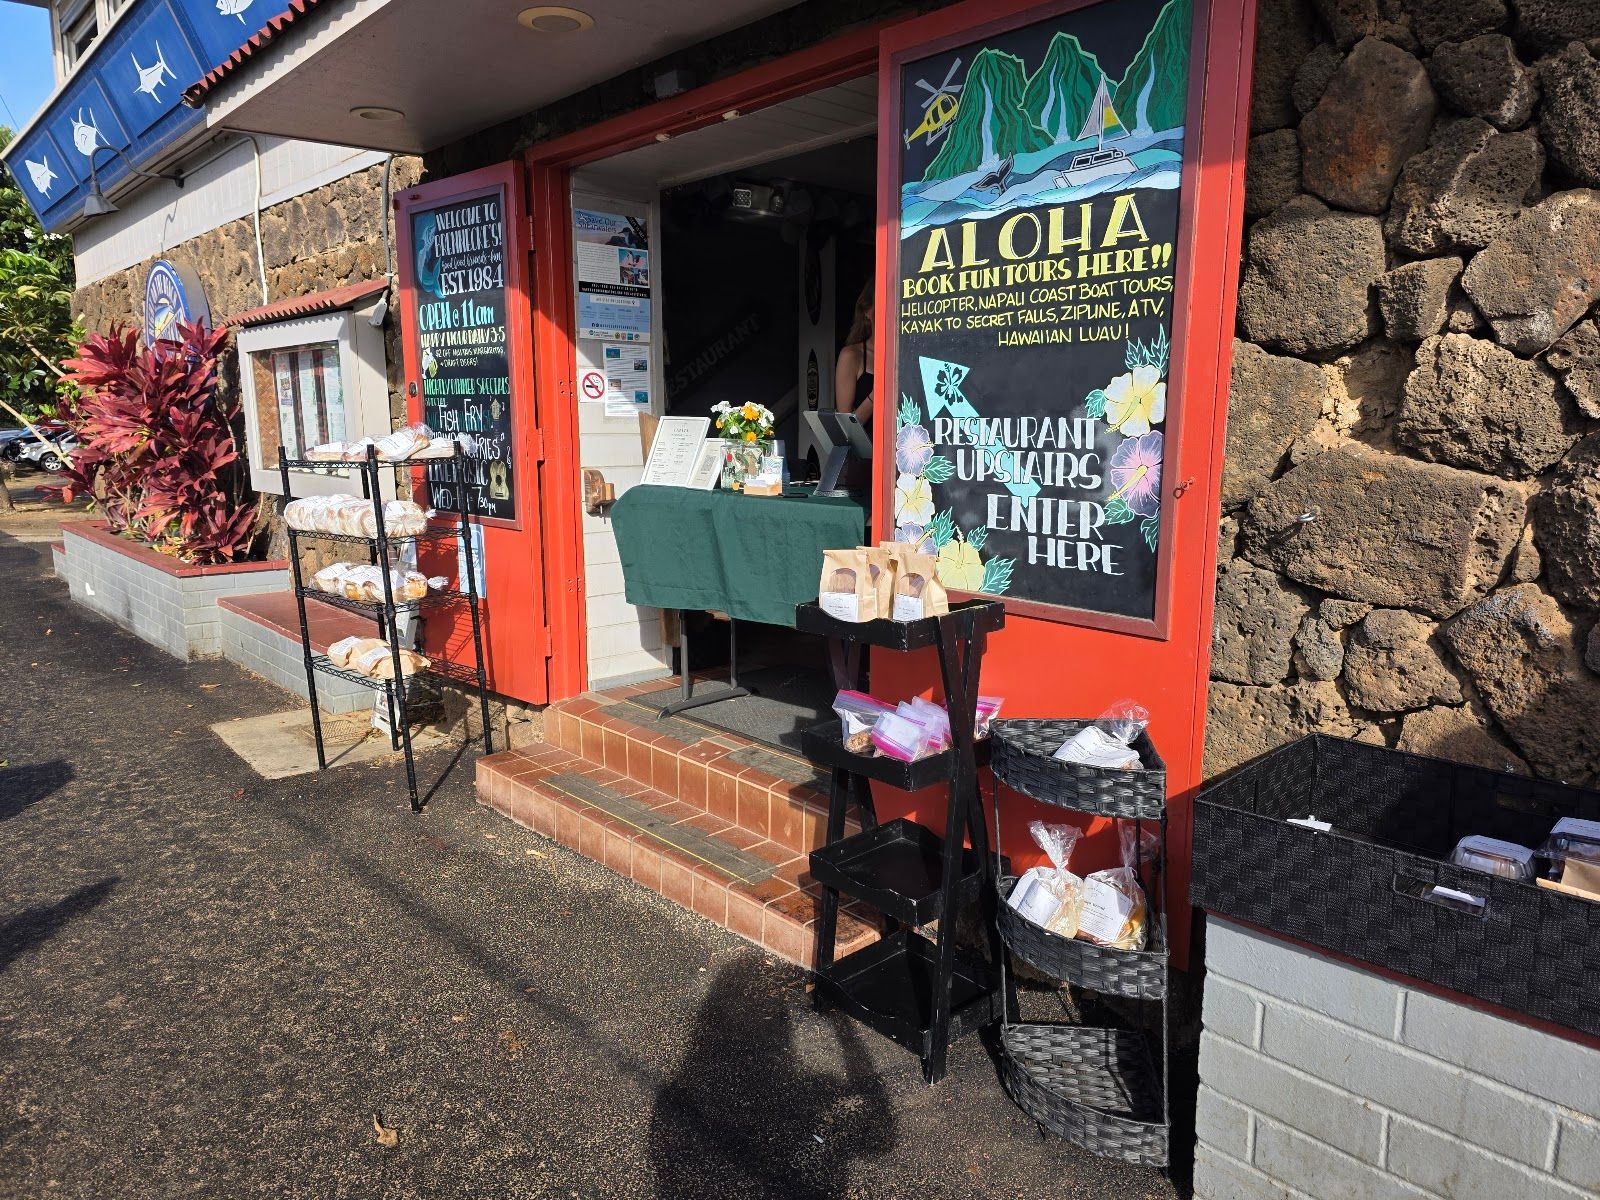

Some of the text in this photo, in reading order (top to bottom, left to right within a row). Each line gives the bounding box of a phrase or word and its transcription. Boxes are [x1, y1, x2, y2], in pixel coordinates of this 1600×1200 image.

[436, 203, 498, 231] WELCOME TO
[918, 193, 1150, 273] ALOHA
[902, 242, 1173, 299] BOOK FUN TOURS HERE!!
[978, 291, 1025, 309] NAPALI
[1030, 285, 1076, 304] COAST
[1079, 280, 1119, 300] BOAT
[1122, 276, 1174, 294] TOURS,
[419, 301, 451, 331] OPEN
[901, 319, 943, 334] KAYAK
[945, 318, 962, 329] TO
[967, 312, 1014, 328] SECRET
[1018, 310, 1060, 326] FALLS,
[421, 332, 446, 348] HAPPY
[447, 330, 468, 346] HOUR
[468, 328, 490, 344] DAILY
[998, 329, 1072, 347] HAWAIIAN
[463, 398, 483, 433] FRY
[933, 416, 1101, 450] RESTAURANT
[956, 449, 1102, 490] UPSTAIRS
[986, 493, 1105, 541] ENTER
[1028, 535, 1125, 576] HERE
